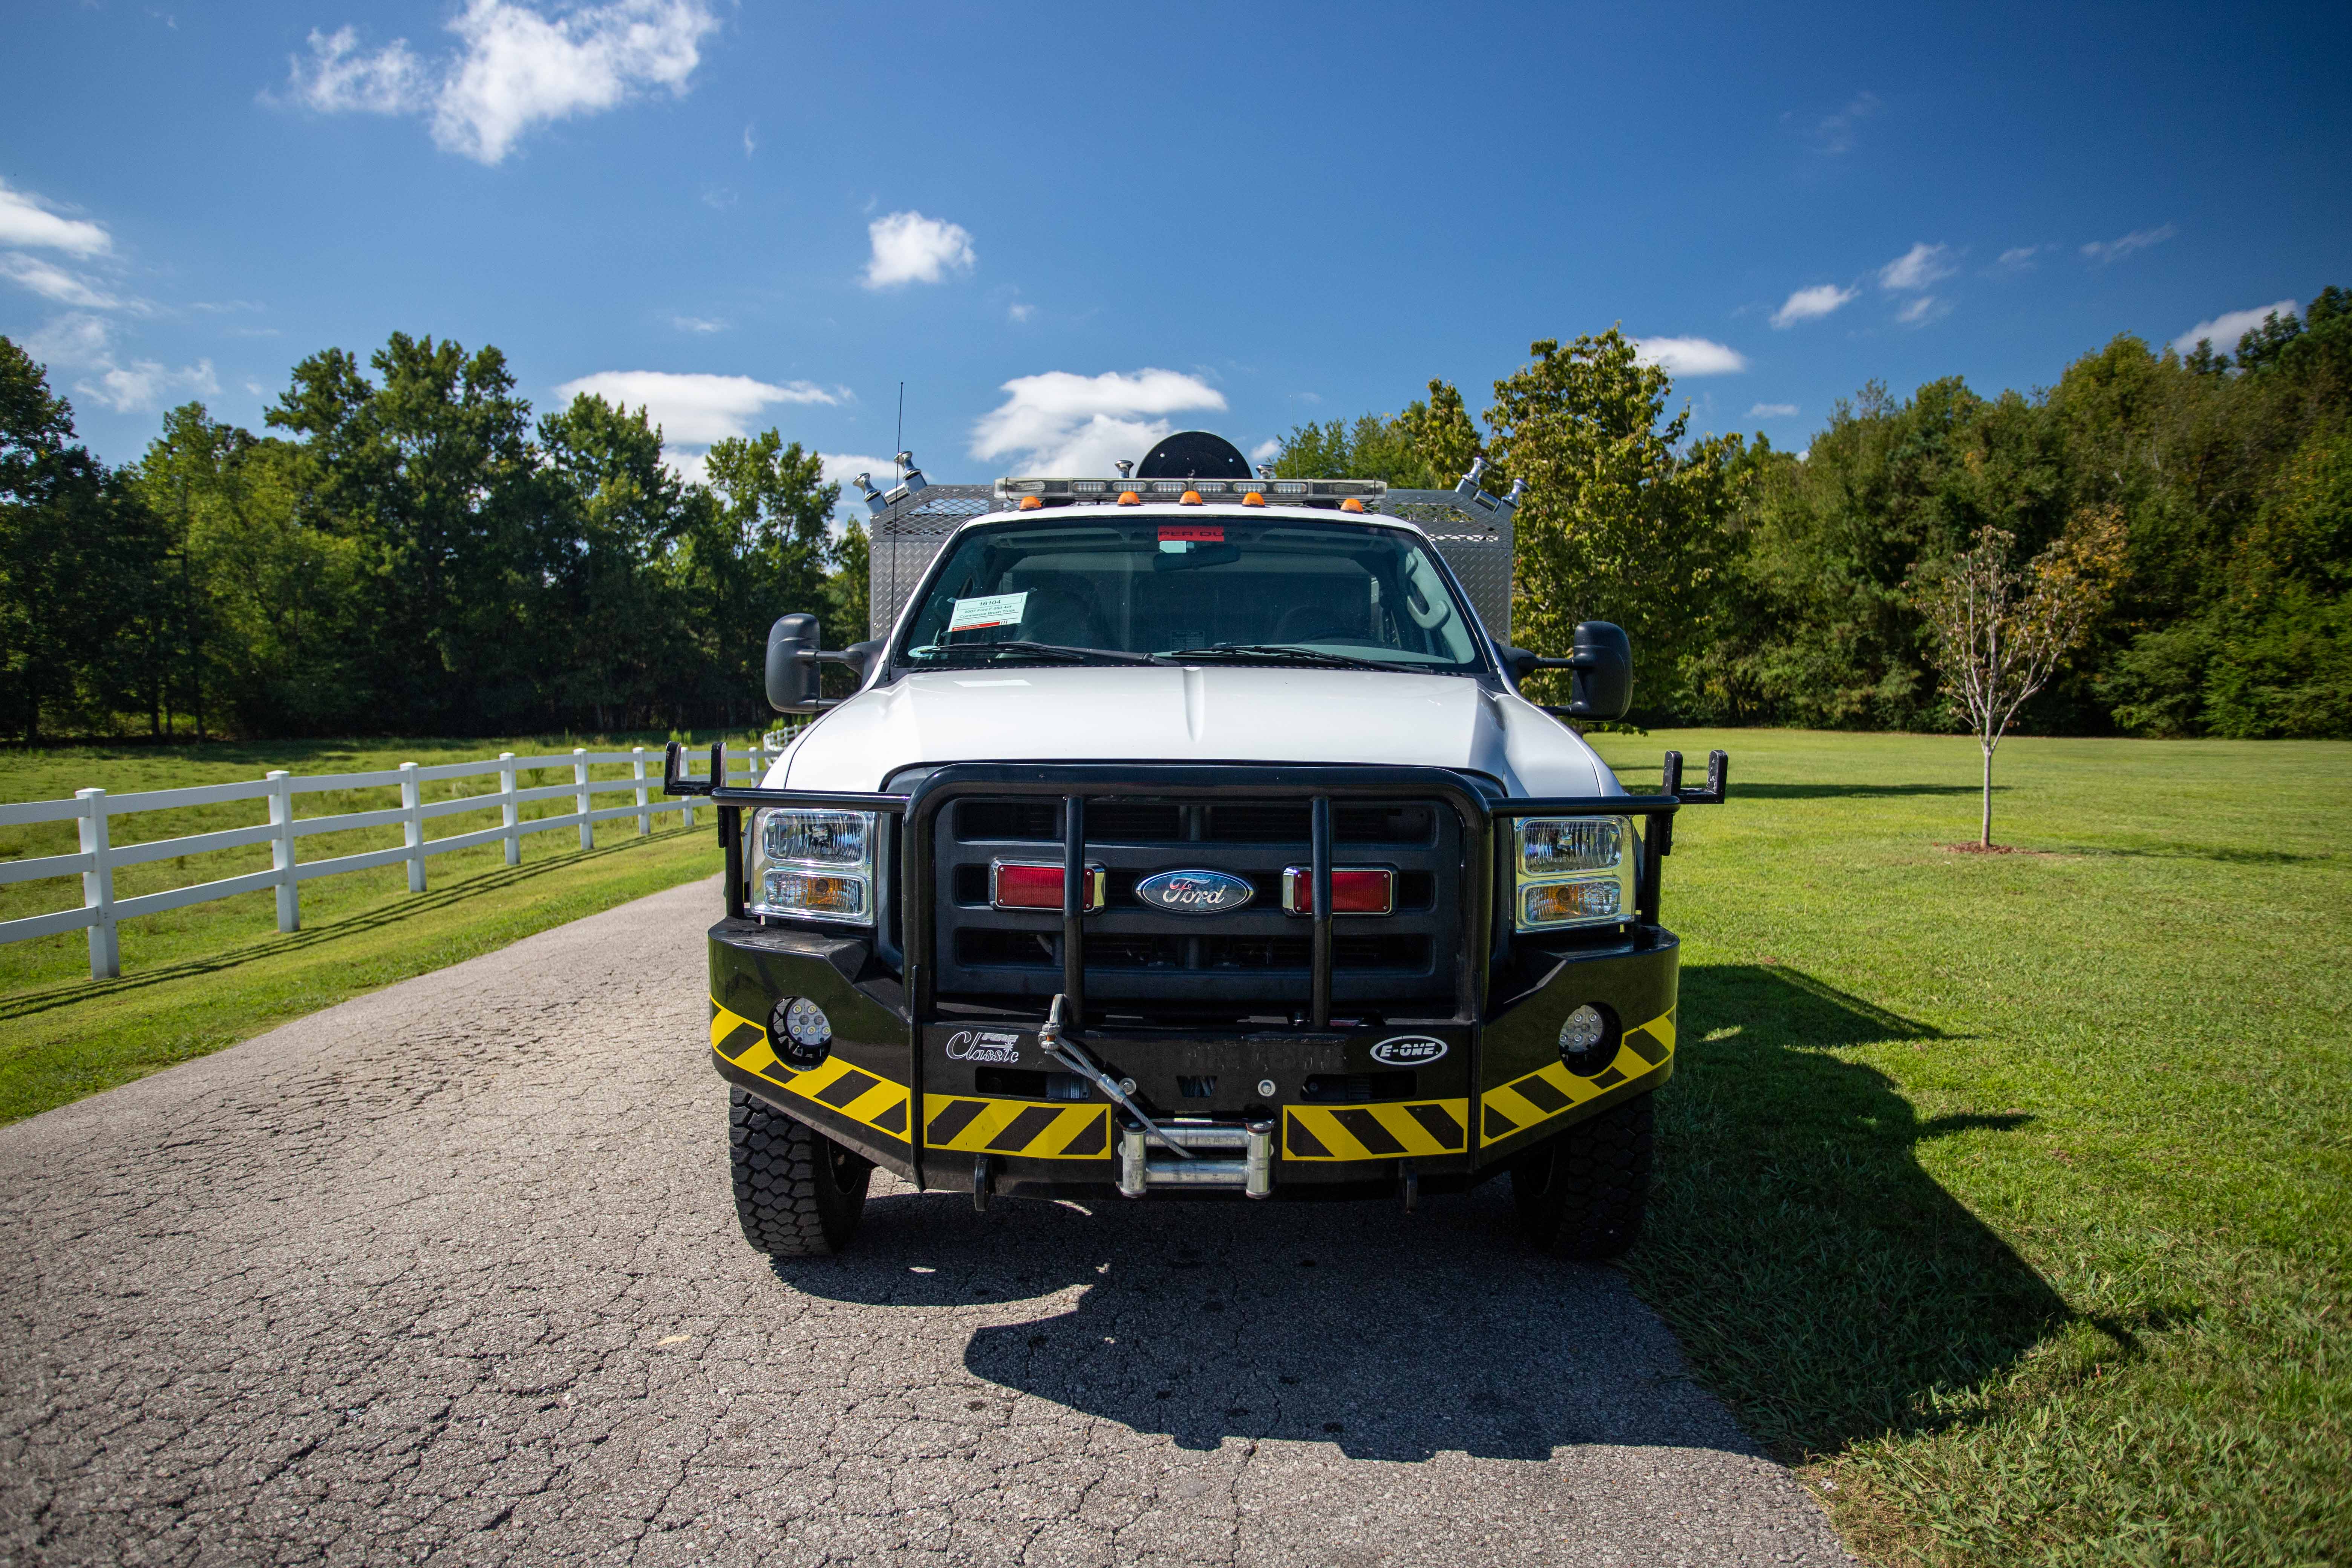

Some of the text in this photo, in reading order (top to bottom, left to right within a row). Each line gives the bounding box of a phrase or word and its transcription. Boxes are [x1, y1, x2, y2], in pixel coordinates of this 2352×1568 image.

[1162, 878, 1227, 904] Ford
[946, 1031, 1019, 1063] Classic
[982, 1033, 1019, 1043] FIRE
